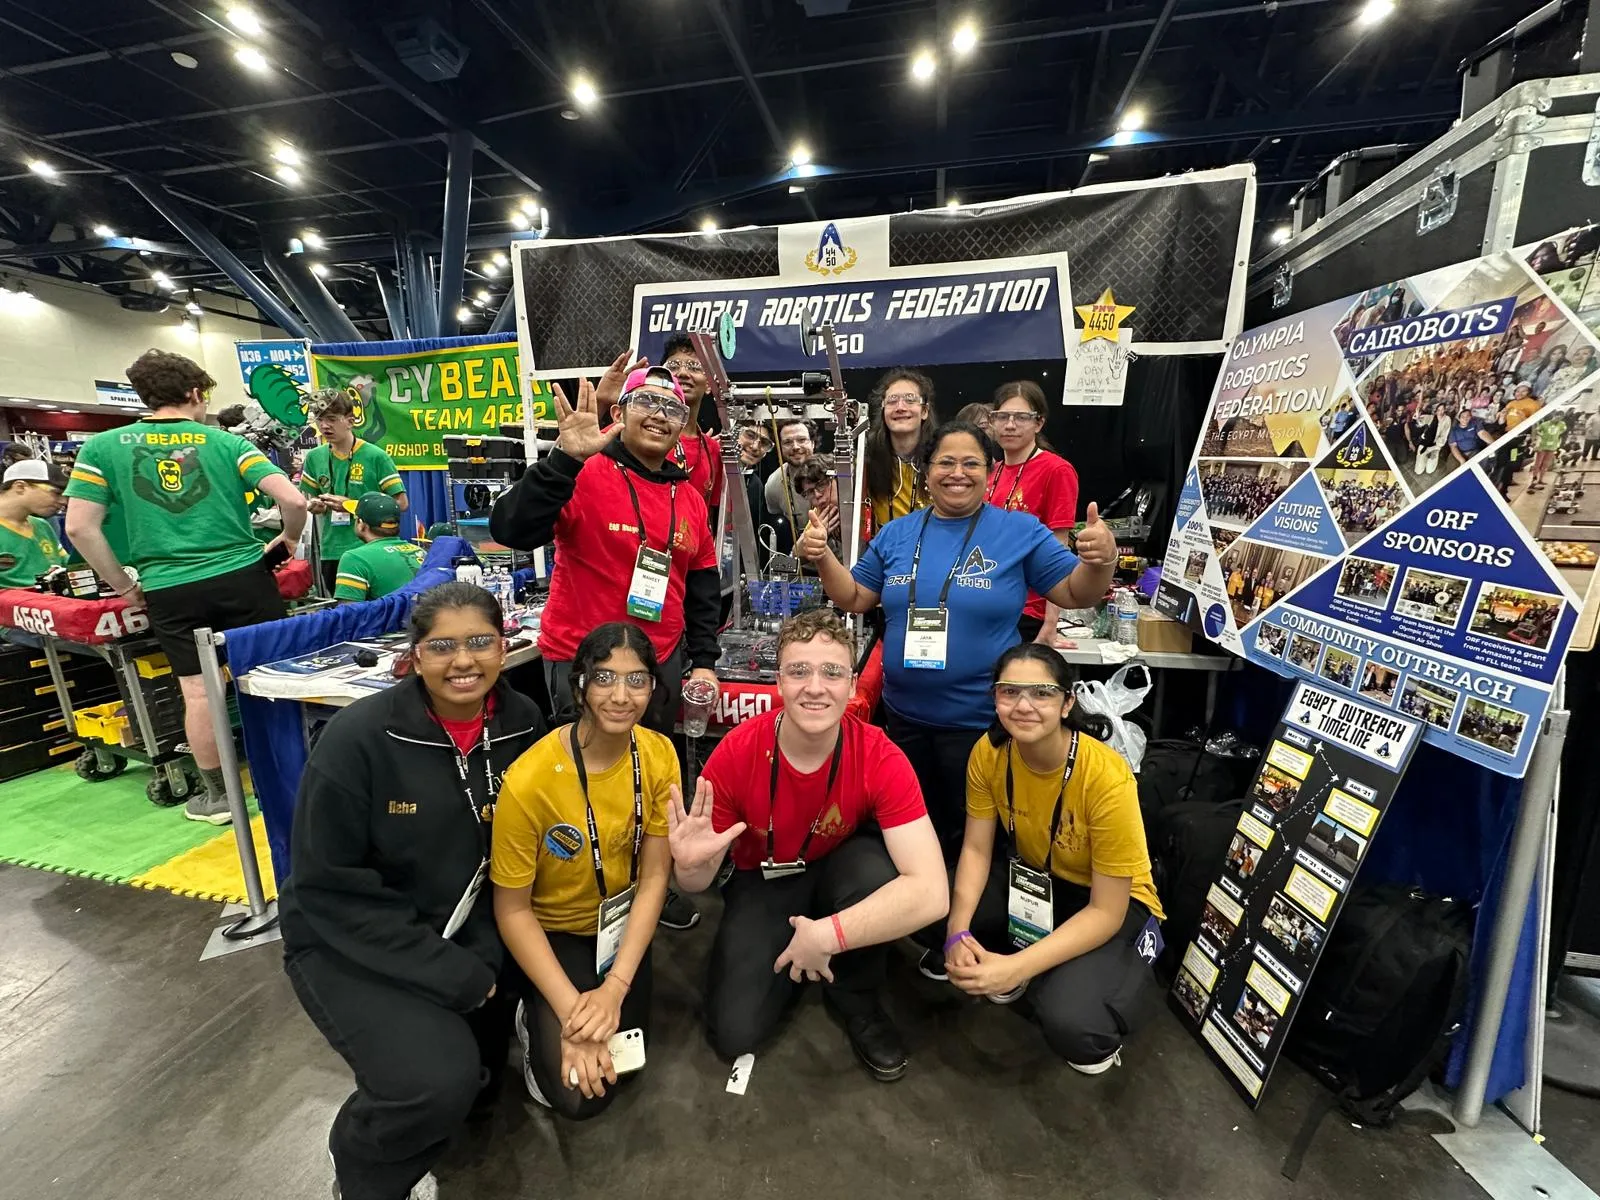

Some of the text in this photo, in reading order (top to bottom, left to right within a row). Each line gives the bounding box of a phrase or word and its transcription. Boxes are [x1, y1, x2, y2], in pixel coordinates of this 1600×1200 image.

[826, 248, 836, 256] 44
[826, 257, 836, 266] 50
[758, 292, 874, 328] ROBOTICS
[885, 278, 1050, 320] FEDERATION
[1089, 313, 1115, 331] 4450
[1350, 304, 1503, 354] CAIROBOTS
[812, 334, 864, 356] 450
[1233, 321, 1304, 360] OLYMPIA
[385, 355, 552, 403] CYBEA
[1084, 366, 1104, 375] DAY
[1222, 353, 1310, 391] ROBOTICS
[1214, 385, 1328, 420] FEDERATION
[409, 408, 473, 430] TEAM
[120, 432, 206, 446] CYBEARS
[1211, 427, 1304, 441] THE EGYPT MISSION
[386, 443, 429, 456] BISHOP
[1277, 502, 1323, 518] FUTURE
[1426, 508, 1478, 531] ORF
[1187, 521, 1204, 532] 100%
[1274, 516, 1319, 534] VISIONS
[1383, 531, 1515, 568] SPONSORS
[886, 575, 911, 586] ORF
[957, 576, 992, 589] 4450
[1329, 604, 1346, 613] Olympic
[13, 605, 58, 636] 4682
[94, 606, 150, 638] 46
[1402, 618, 1417, 626] team
[1418, 621, 1435, 631] booth
[1444, 628, 1455, 637] the
[1392, 630, 1416, 641] Museum
[1426, 640, 1444, 649] Show
[1399, 624, 1440, 641] Olympic Flight
[1280, 611, 1516, 704] COMMUNITY OUTREACH
[1463, 643, 1480, 652] from
[1481, 648, 1512, 661] Amazon
[1523, 660, 1544, 669] start
[1481, 640, 1515, 654] receiving
[1523, 652, 1547, 662] grant
[1500, 662, 1522, 672] team.
[1300, 689, 1407, 743] EGYPT OUTREACH
[1318, 714, 1372, 749] TIMELINE
[1349, 783, 1361, 792] AUG
[1298, 853, 1308, 861] OCT
[1320, 868, 1332, 878] MAR
[1333, 876, 1342, 885] '22
